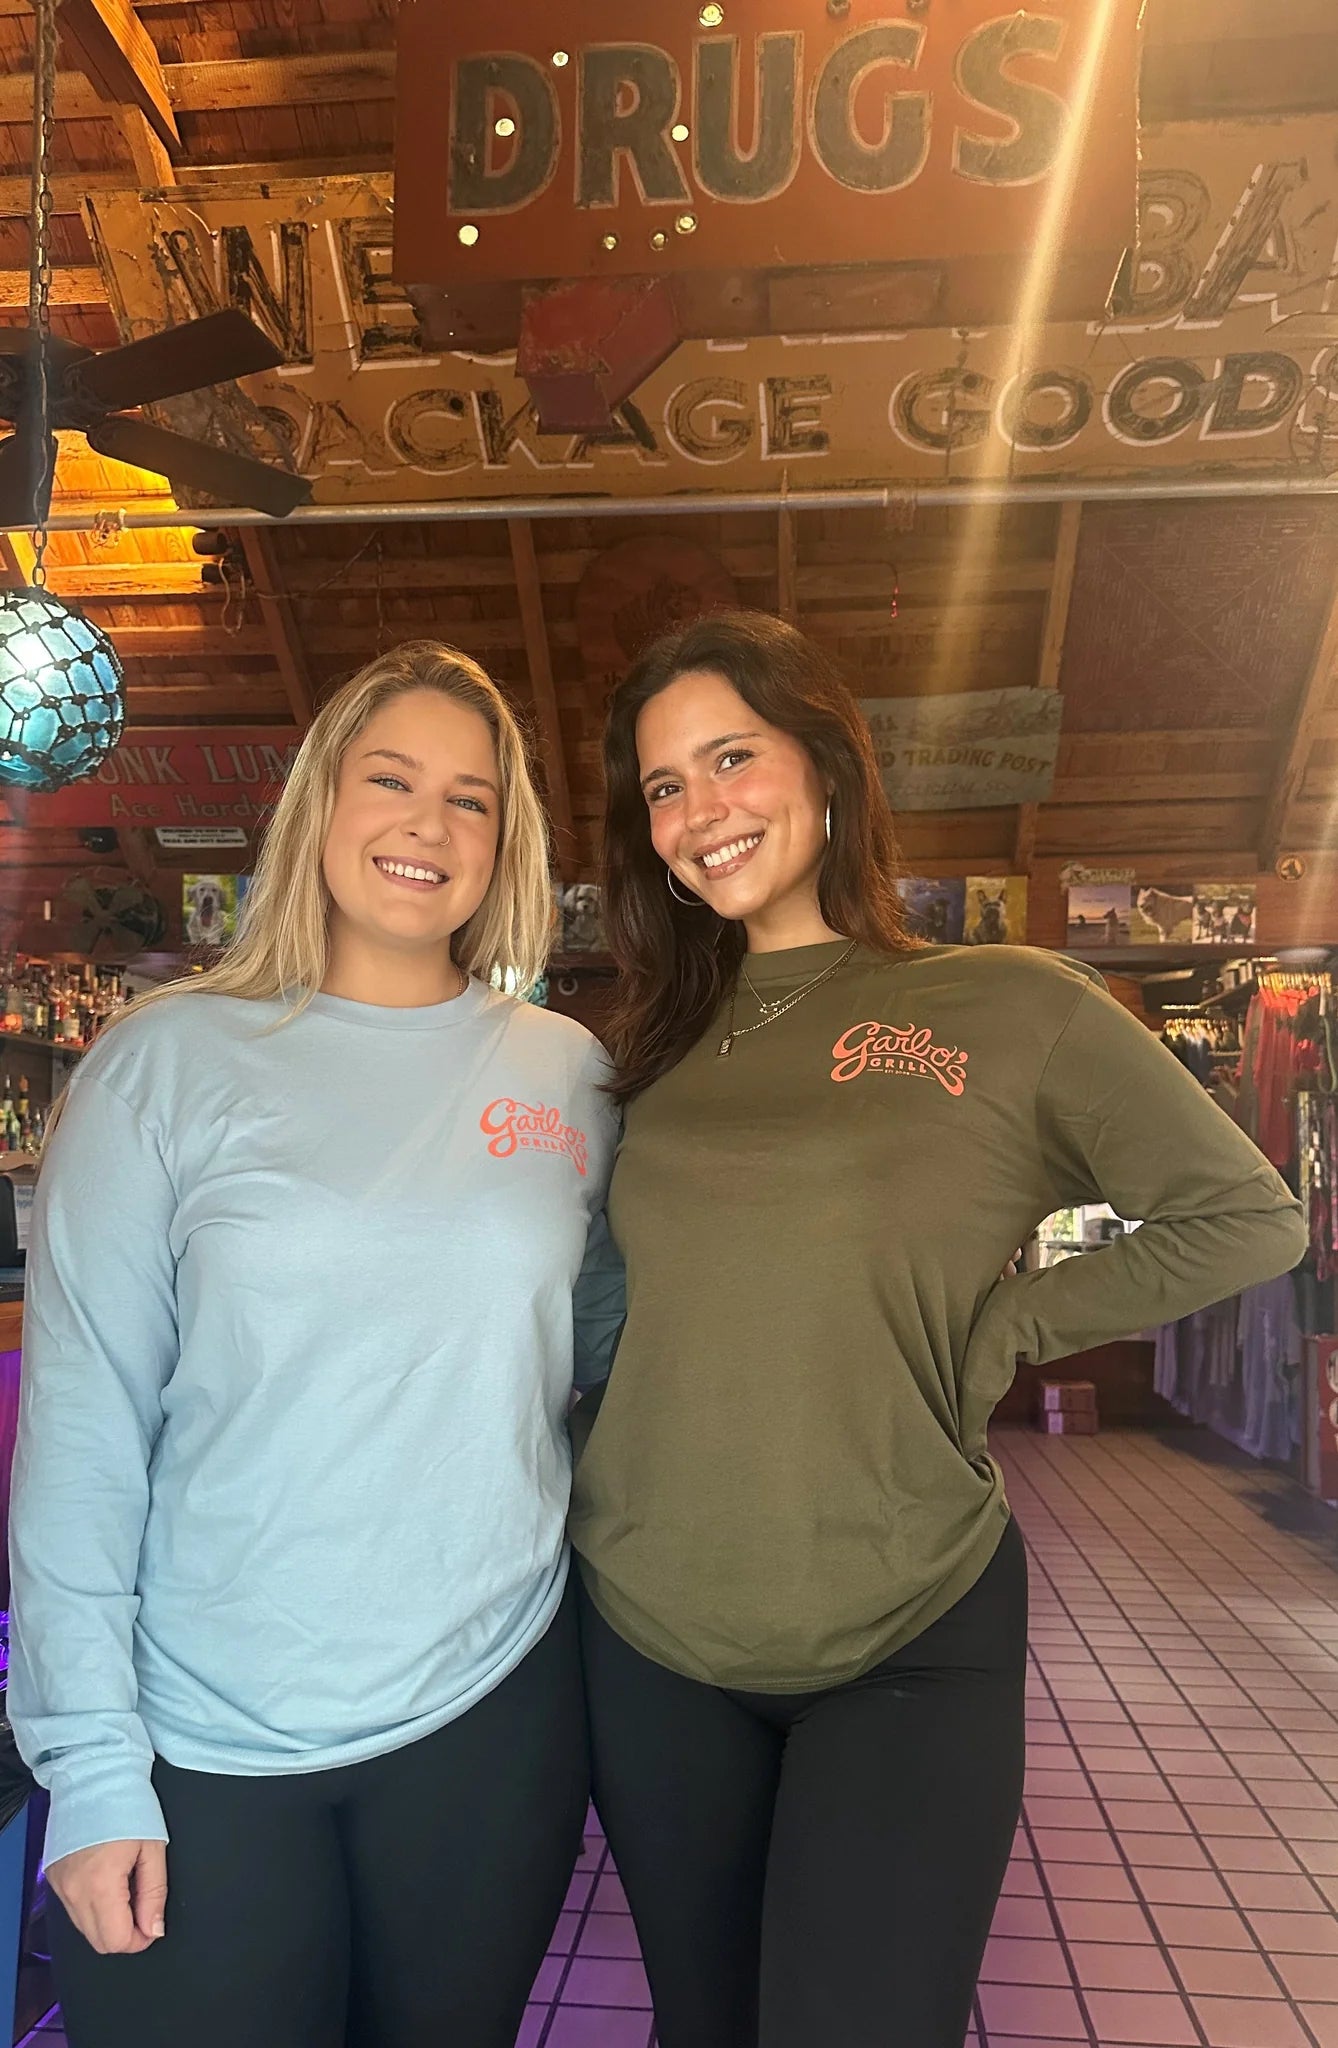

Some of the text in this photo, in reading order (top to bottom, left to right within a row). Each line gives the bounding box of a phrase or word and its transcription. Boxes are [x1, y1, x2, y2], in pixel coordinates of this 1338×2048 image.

[446, 12, 1074, 216] DRUGS
[1086, 157, 1338, 335] BA
[901, 747, 996, 768] TRADING
[999, 751, 1052, 775] POST
[110, 792, 277, 818] Ace Hardw
[869, 1057, 928, 1074] GRILL
